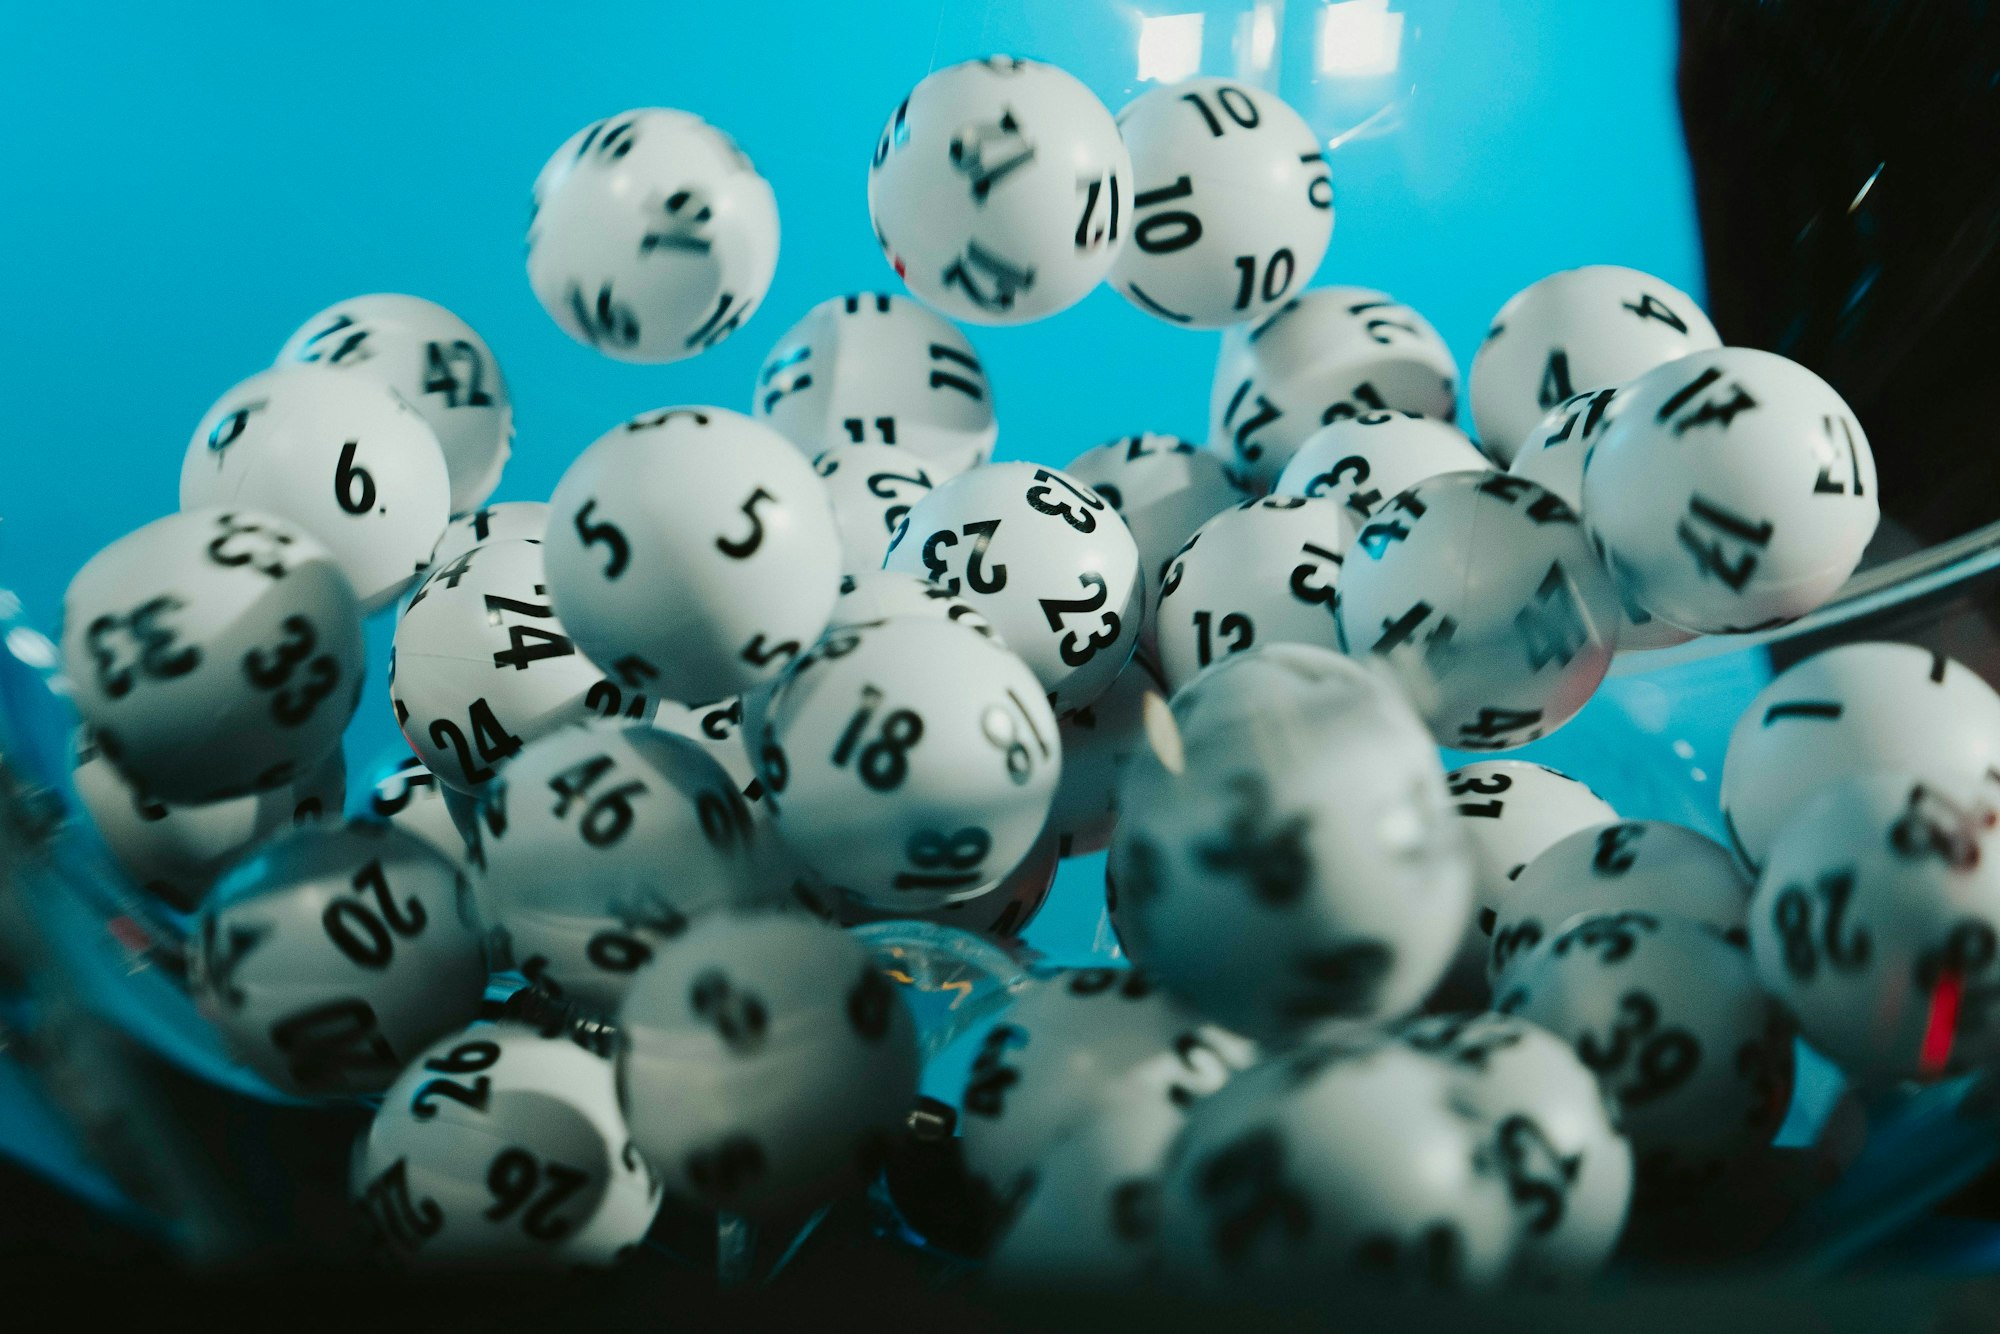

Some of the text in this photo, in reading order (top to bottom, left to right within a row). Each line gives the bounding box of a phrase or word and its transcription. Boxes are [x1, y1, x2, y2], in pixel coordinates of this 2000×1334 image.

[1184, 87, 1260, 138] 10
[1132, 175, 1202, 255] 10
[1300, 153, 1335, 210] 10
[1233, 248, 1294, 311] 10
[1623, 293, 1688, 334] 4
[424, 338, 494, 406] 42
[929, 342, 983, 401] 11
[845, 415, 897, 445] 11
[573, 498, 631, 580] 5
[713, 486, 778, 561] 5
[1026, 468, 1105, 534] 23
[921, 518, 1007, 600] 23
[1676, 494, 1774, 596] 17
[1038, 569, 1122, 668] 23
[246, 614, 340, 730] 33
[428, 696, 526, 786] 24
[829, 682, 926, 793] 18
[1762, 702, 1843, 728] 1
[548, 752, 650, 850] 46
[891, 825, 993, 892] 18
[321, 857, 428, 971] 20
[1773, 868, 1873, 980] 28
[407, 1039, 501, 1123] 26
[1572, 988, 1702, 1110] 39
[481, 1142, 589, 1244] 26
